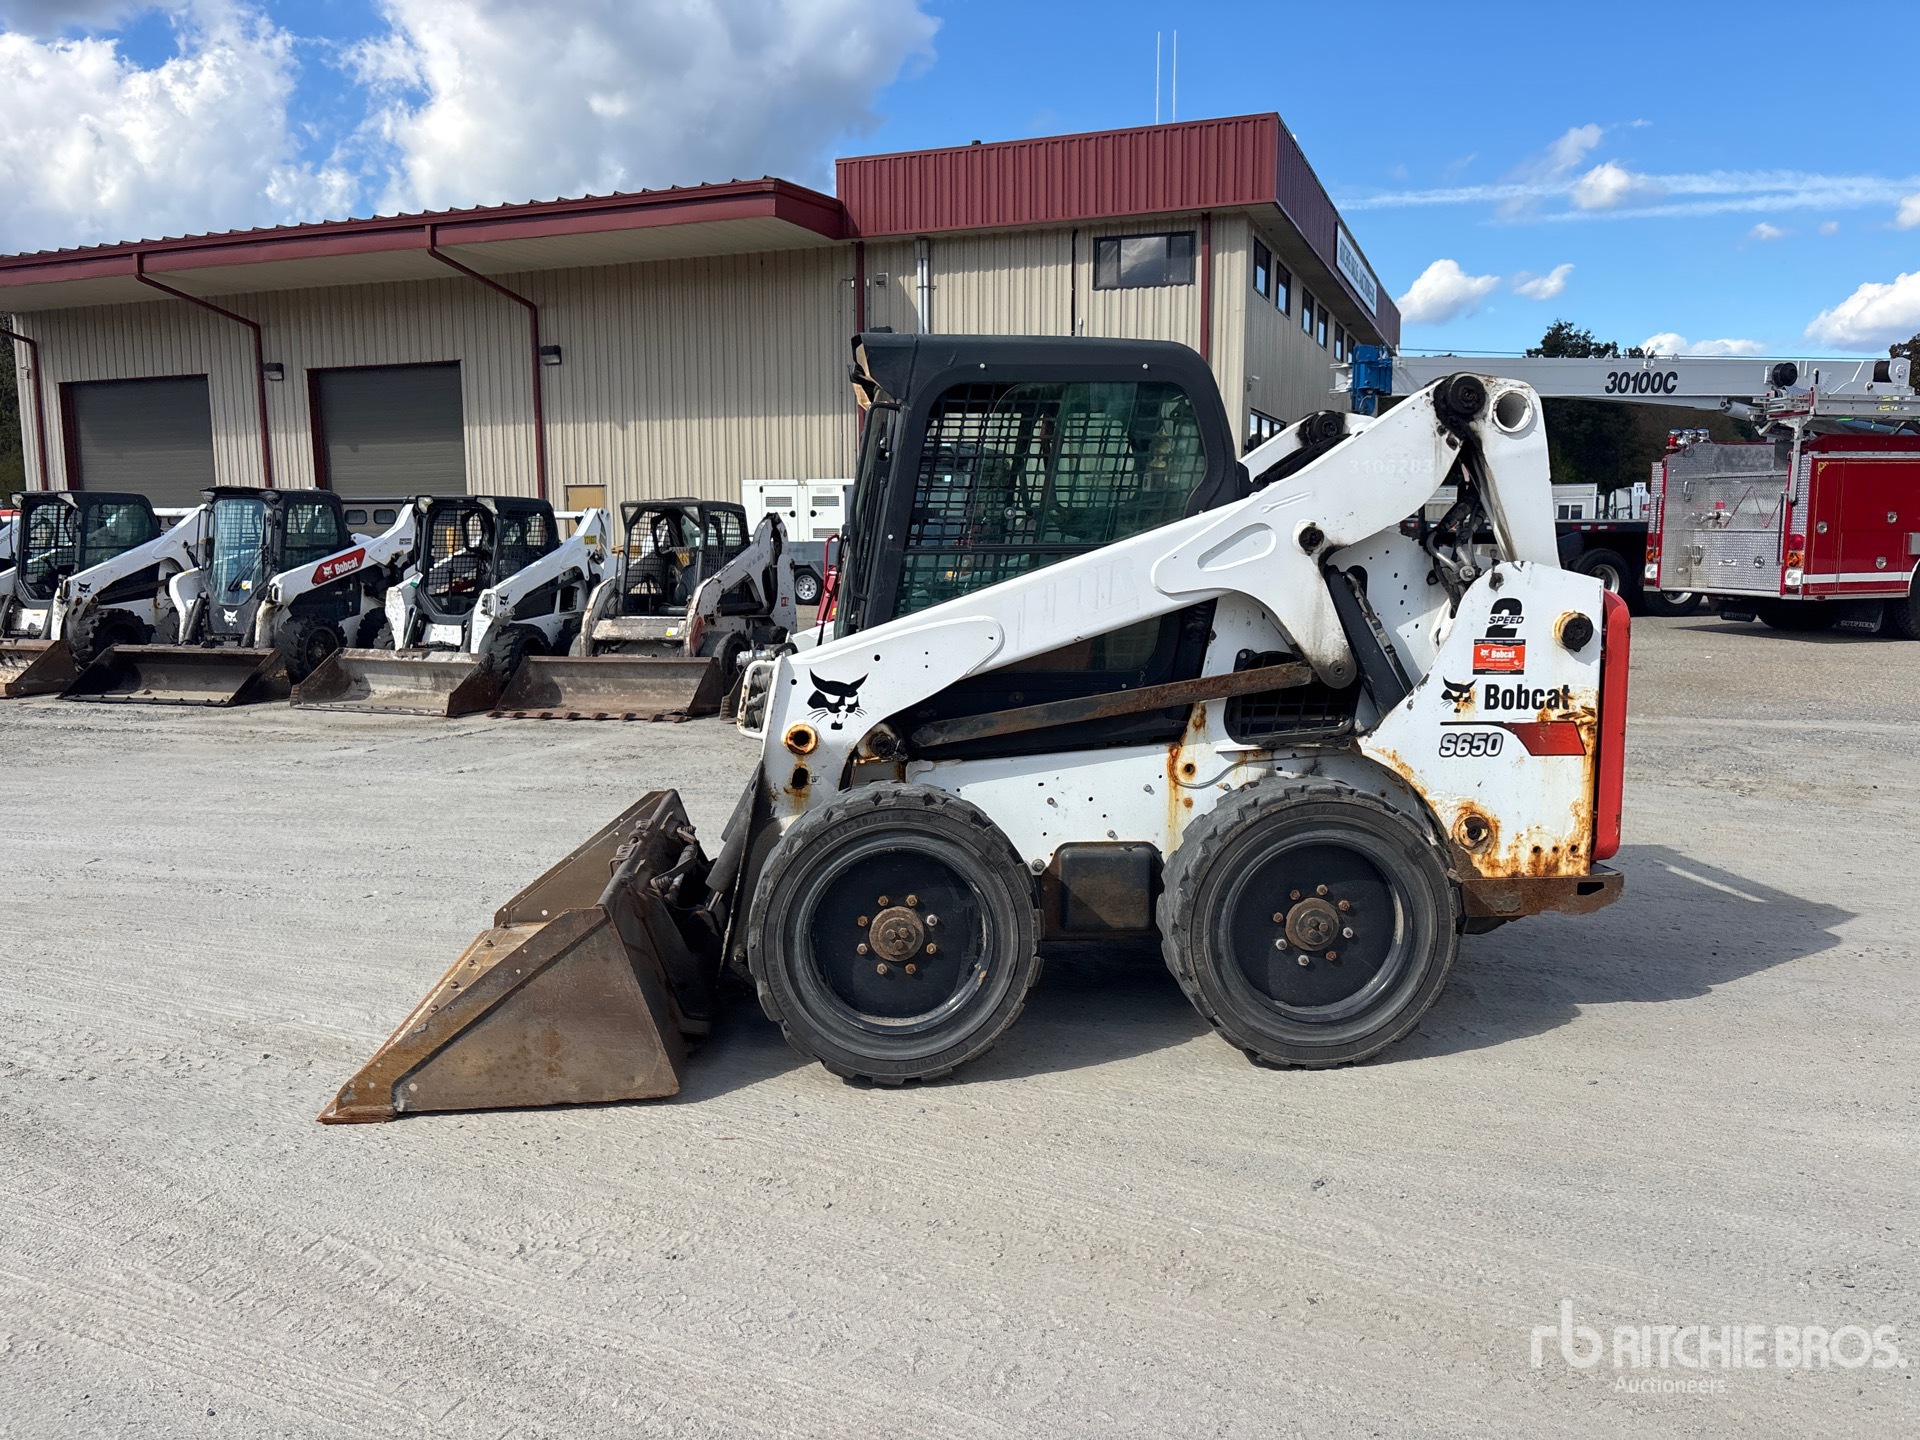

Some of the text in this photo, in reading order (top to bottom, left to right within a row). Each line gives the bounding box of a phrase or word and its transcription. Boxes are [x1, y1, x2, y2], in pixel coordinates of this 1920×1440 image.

[1605, 371, 1678, 394] 30100C
[334, 557, 358, 574] Bobcat
[1488, 615, 1524, 625] SPEED
[1491, 650, 1516, 659] Bobcat
[1484, 684, 1570, 710] Bobcat
[1439, 732, 1503, 757] S650
